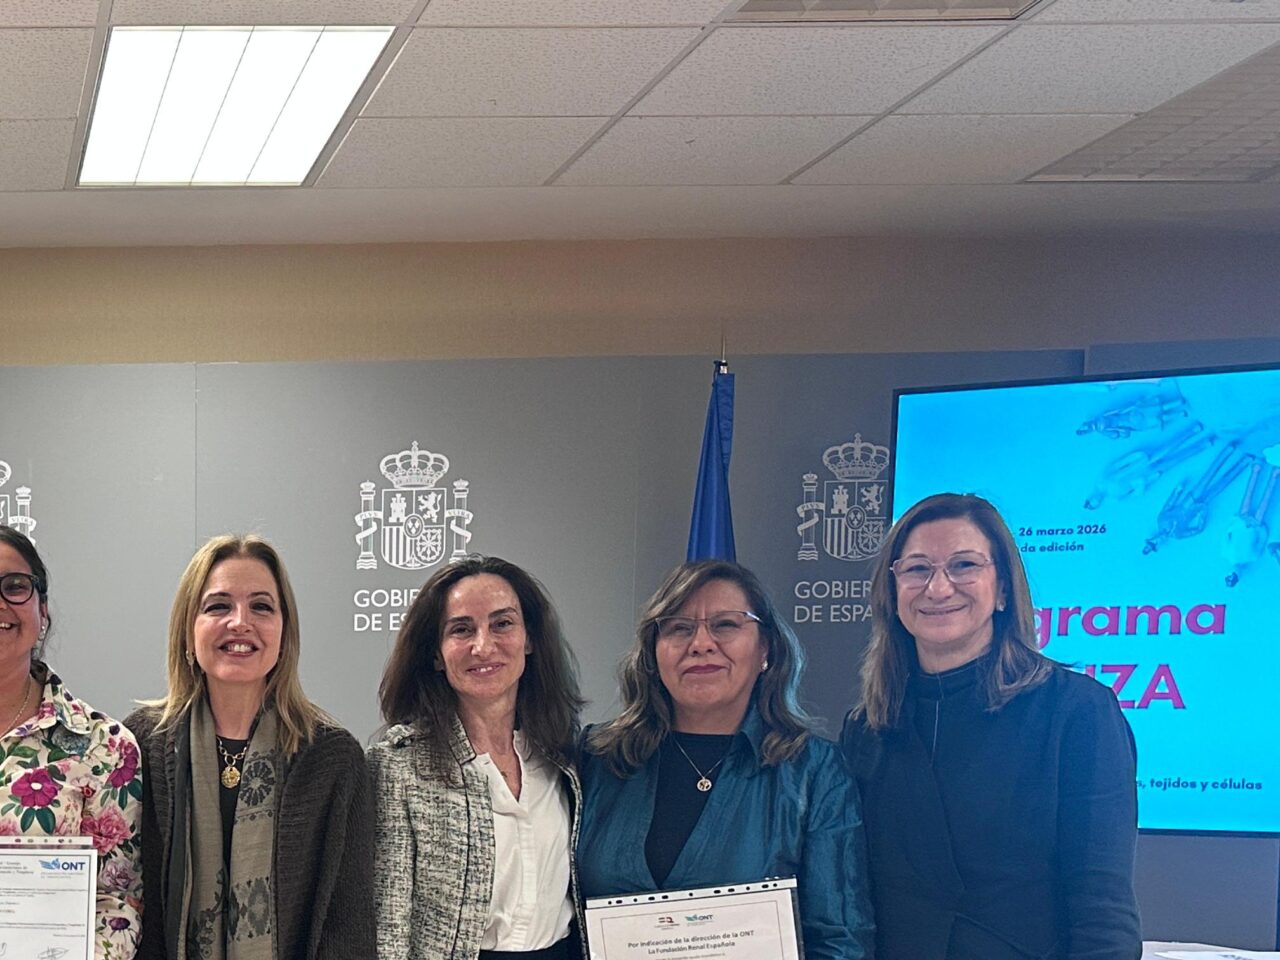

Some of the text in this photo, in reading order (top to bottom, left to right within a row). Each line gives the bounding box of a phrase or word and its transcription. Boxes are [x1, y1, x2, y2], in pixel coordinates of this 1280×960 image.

[1019, 523, 1107, 537] 26 marzo 2026
[1039, 540, 1085, 552] edición
[794, 581, 873, 599] GOBIER
[794, 604, 873, 623] DE ESPA
[353, 613, 382, 632] DE
[1085, 663, 1187, 710] ZA
[1150, 777, 1197, 791] tejidos
[1200, 780, 1209, 792] y
[1211, 778, 1263, 791] células
[61, 861, 86, 871] ONT
[640, 938, 673, 947] indicación
[691, 934, 721, 943] dirección
[722, 931, 731, 940] de
[739, 930, 755, 938] ONT
[687, 943, 706, 951] Renal
